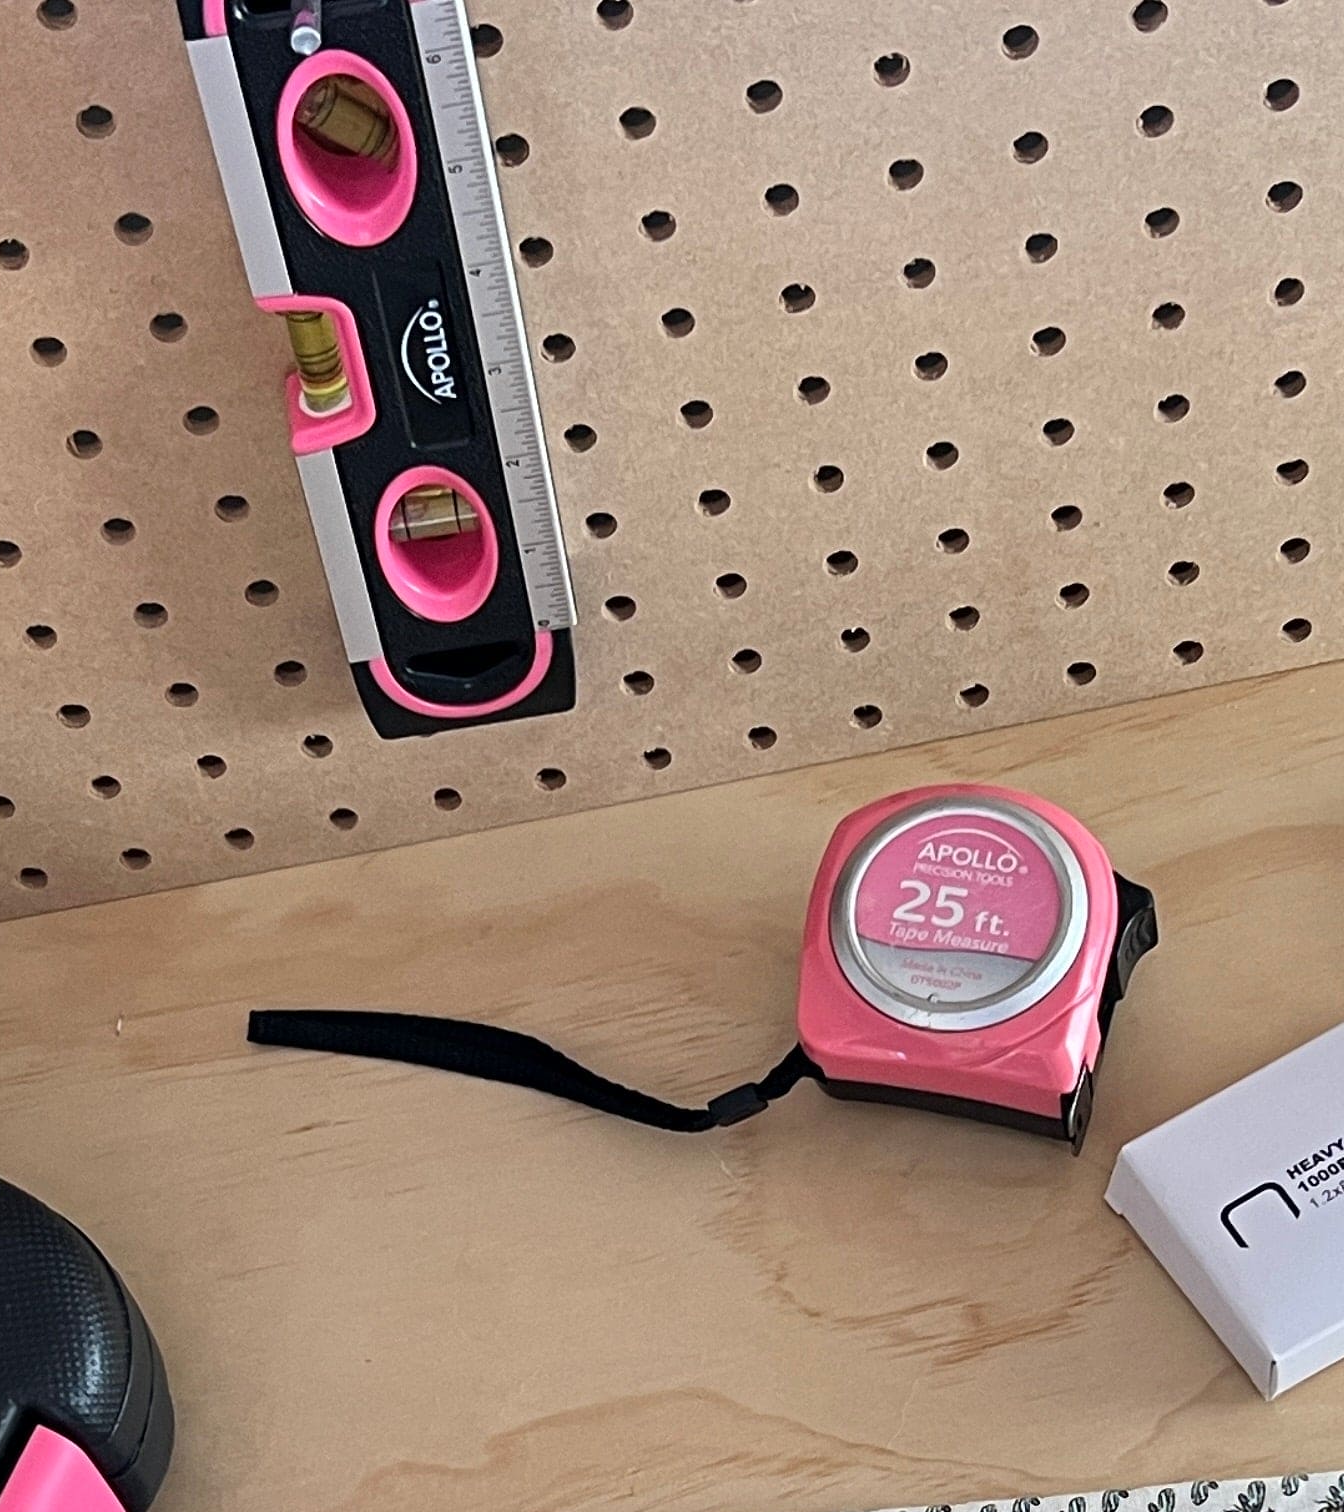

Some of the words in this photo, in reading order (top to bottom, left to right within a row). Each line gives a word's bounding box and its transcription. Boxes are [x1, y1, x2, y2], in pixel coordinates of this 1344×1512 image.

[425, 54, 442, 64] 6
[447, 163, 463, 174] 5
[468, 267, 481, 277] 4
[487, 366, 502, 376] 3
[505, 458, 520, 468] 2
[523, 546, 537, 555] 1
[975, 874, 1015, 888] TOOLS
[892, 879, 969, 928] 25
[974, 911, 1010, 937] ft.
[889, 921, 929, 943] Tape
[933, 928, 1010, 954] Measure
[1286, 1137, 1344, 1180] HEAVY
